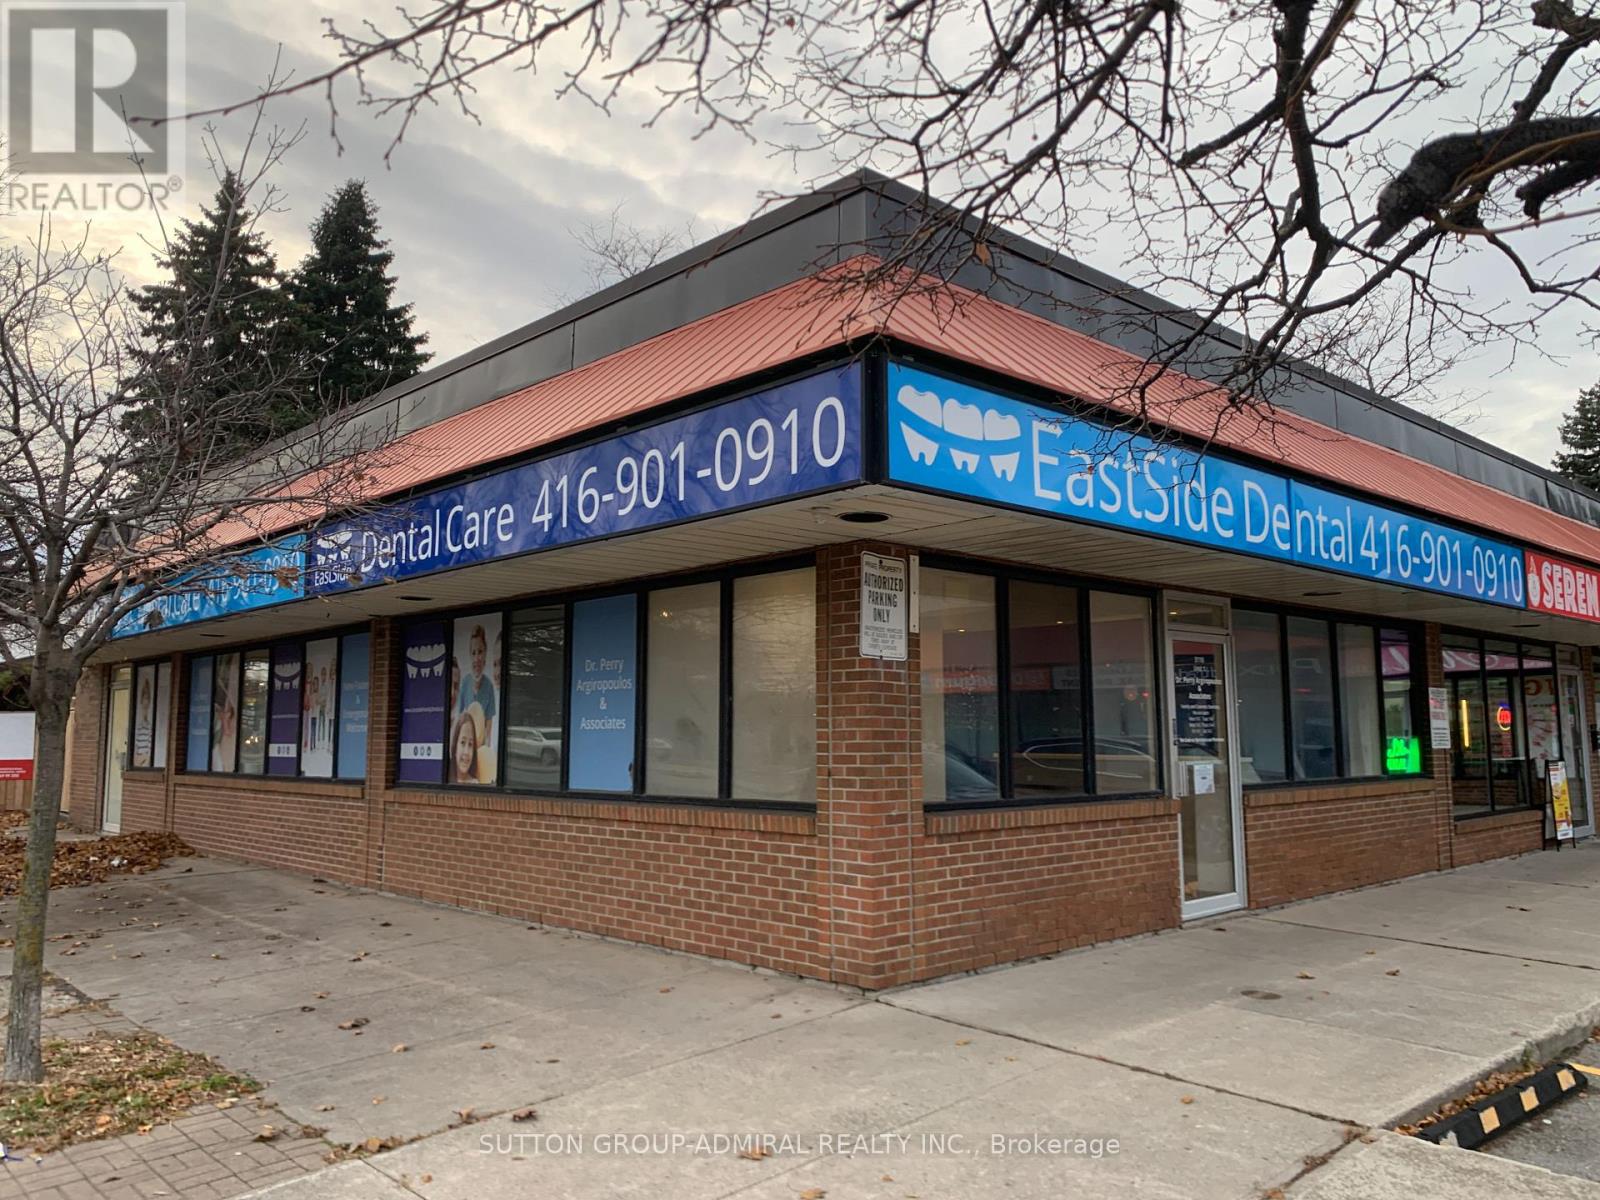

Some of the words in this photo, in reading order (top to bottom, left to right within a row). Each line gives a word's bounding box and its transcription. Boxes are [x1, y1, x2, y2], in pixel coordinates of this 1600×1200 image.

[361, 510, 440, 573] Dental
[446, 503, 515, 553] Care
[531, 396, 846, 534] 416-901-0910
[1033, 420, 1235, 537] EastSide
[1244, 480, 1353, 564] Dental
[1359, 515, 1523, 602] 416-901-0910
[864, 572, 904, 592] AUTHORIZED
[1541, 561, 1600, 617] SEREN
[868, 590, 898, 608] PARKING
[873, 607, 890, 623] ONLY
[585, 659, 597, 673] Dr.
[600, 657, 624, 674] Perry
[599, 697, 608, 710] &
[580, 716, 626, 730] Associates
